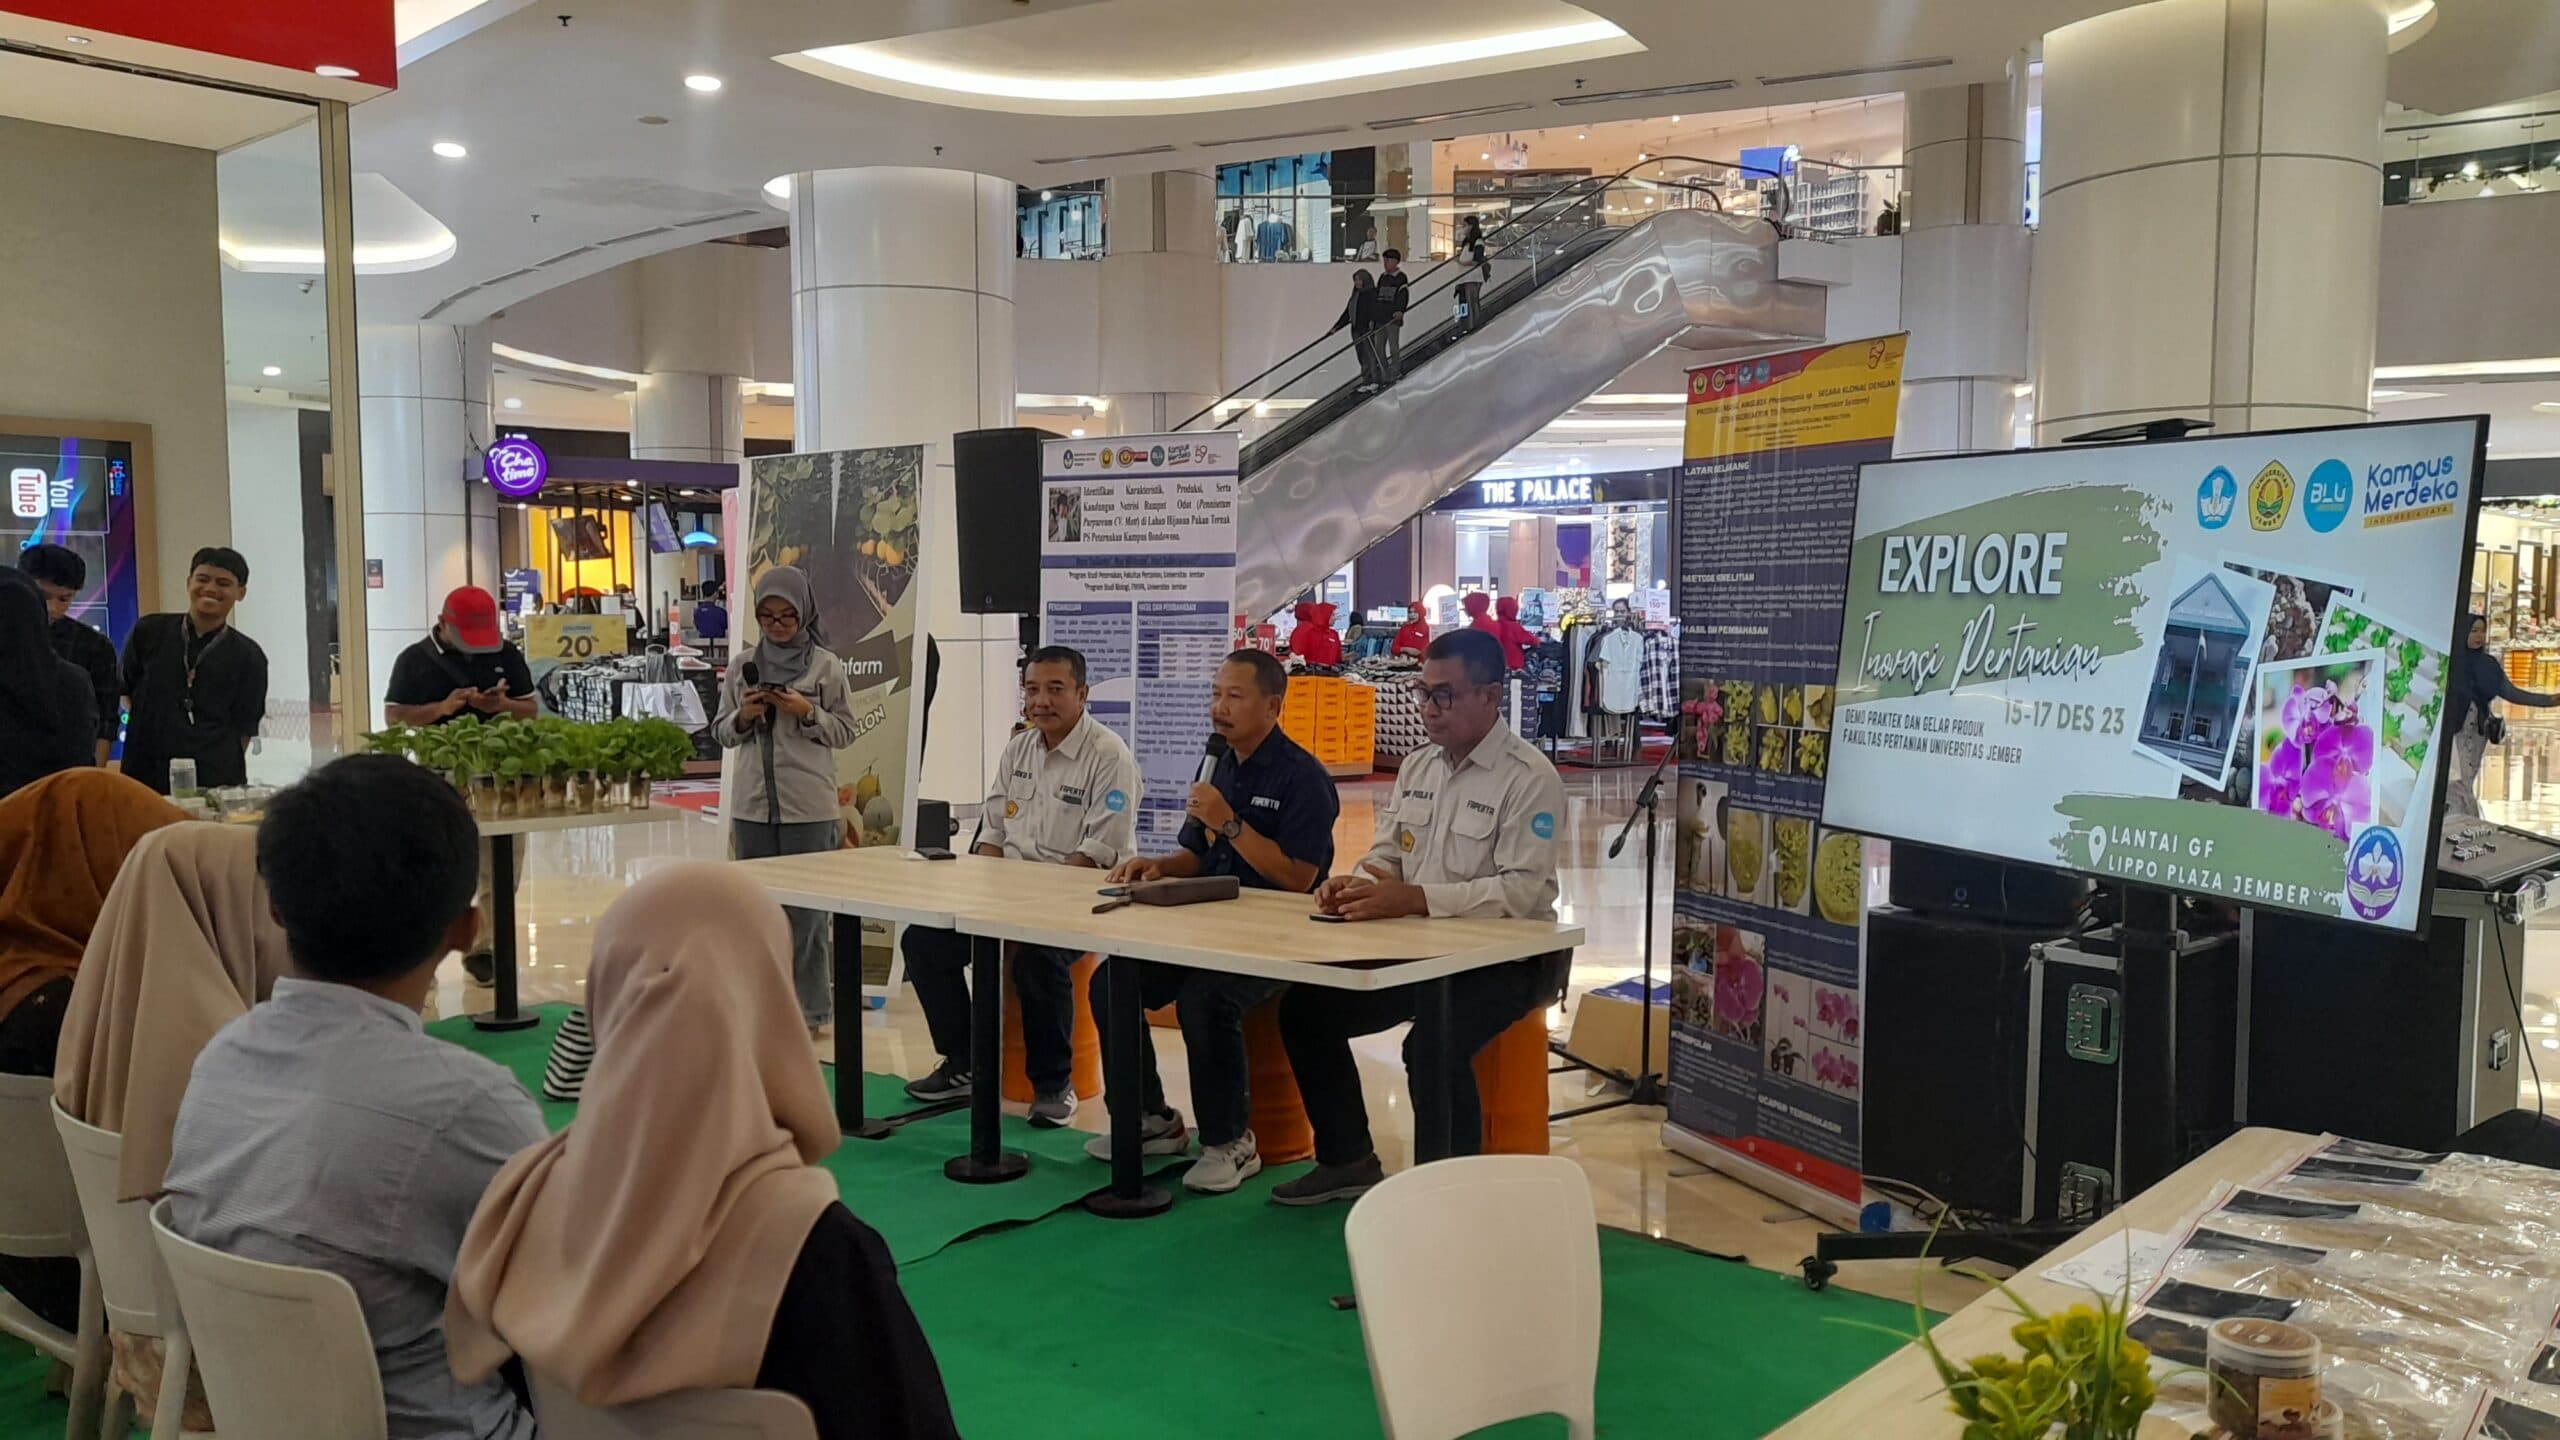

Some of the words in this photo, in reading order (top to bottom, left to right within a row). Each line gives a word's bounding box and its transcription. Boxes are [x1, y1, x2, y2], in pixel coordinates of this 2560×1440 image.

[501, 452, 535, 468] Cha
[501, 466, 535, 482] time
[2366, 455, 2453, 489] Kampus
[18, 473, 41, 514] Tube
[50, 478, 74, 508] You
[1482, 481, 1516, 503] THE
[1522, 477, 1592, 504] PALACE
[2363, 478, 2458, 514] Merdeka
[1880, 532, 2068, 595] EXPLORE
[1854, 610, 1945, 696] Inovasi
[1950, 603, 2103, 696] Pertanian
[1844, 708, 1865, 725] DEMO
[1867, 710, 1902, 730] PRAKTEK
[1904, 713, 1922, 731] DAN
[1923, 714, 1951, 734] GELAR
[1952, 718, 1985, 738] PRODUK
[2004, 698, 2053, 727] 15-17
[2056, 703, 2095, 733] DES
[2100, 707, 2125, 736] 23
[1842, 728, 1882, 748] FAKULTAS
[1884, 731, 1928, 753] PERTANIAN
[1929, 736, 1984, 760] UNIVERSITAS
[1986, 745, 2023, 765] JEMBER
[2111, 824, 2178, 853] LANTAI
[2188, 838, 2215, 859] GF
[2107, 855, 2158, 879] LIPPO
[2167, 864, 2223, 891] PLAZA
[2233, 875, 2310, 906] JEMBER
